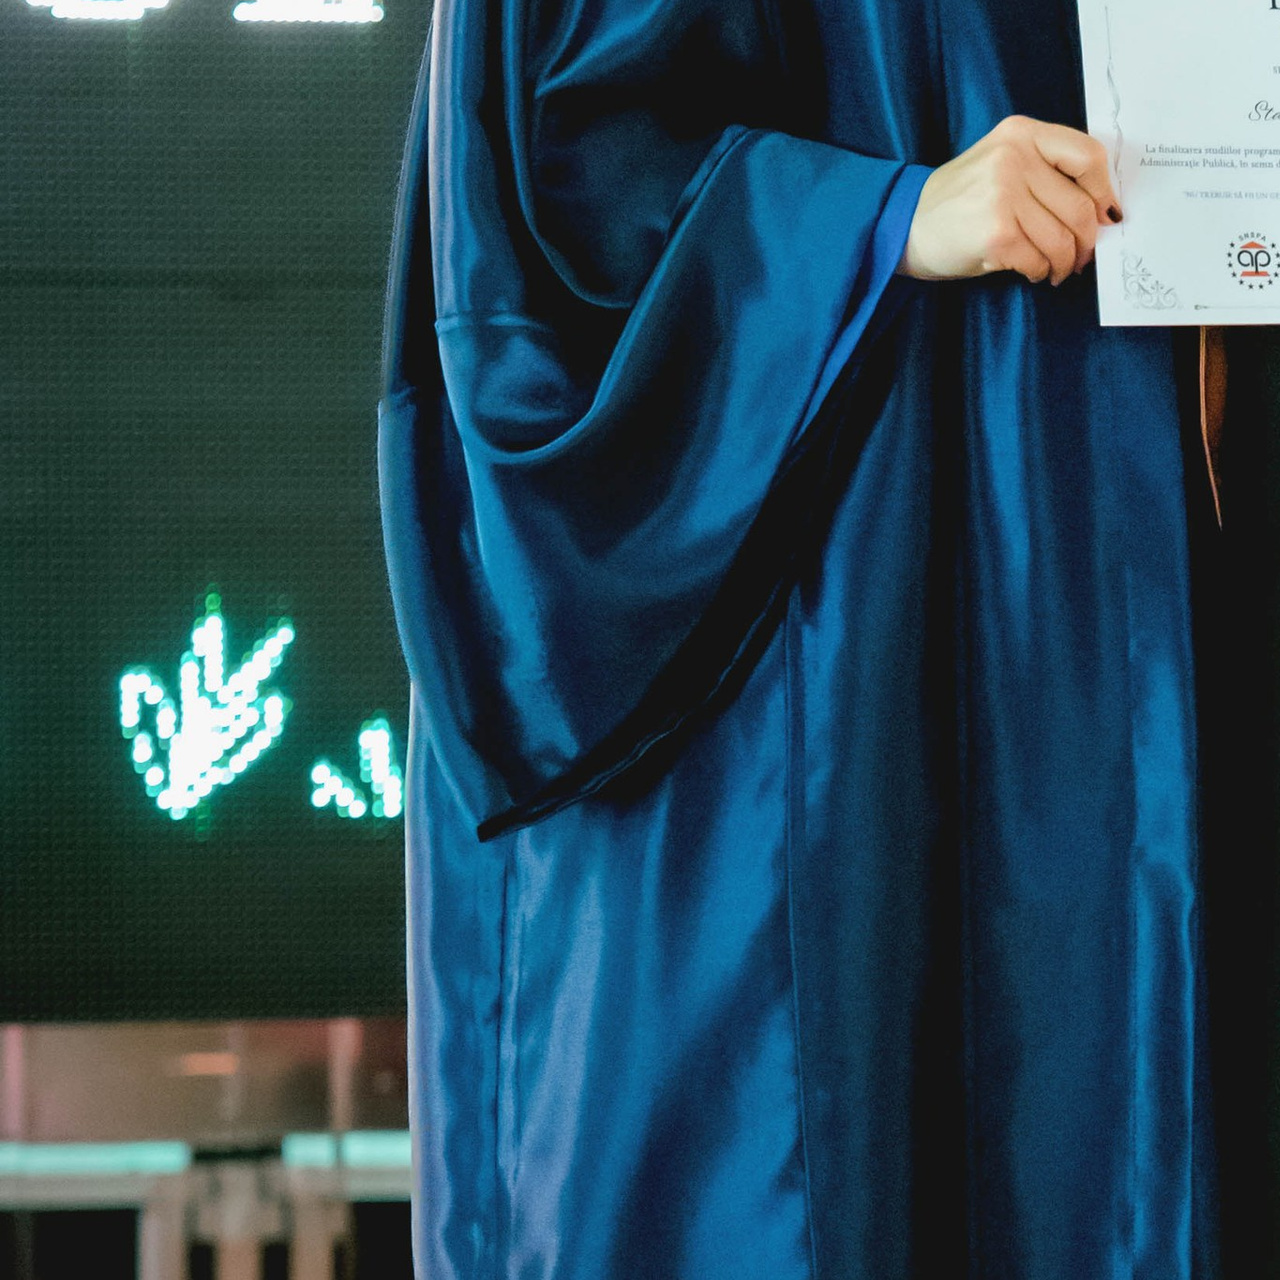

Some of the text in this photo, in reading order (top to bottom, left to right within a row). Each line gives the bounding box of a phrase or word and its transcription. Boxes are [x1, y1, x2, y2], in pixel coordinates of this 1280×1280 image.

[1145, 144, 1156, 153] La
[1158, 144, 1202, 154] finalizarea
[1204, 145, 1241, 154] studiilor
[1238, 231, 1267, 242] SNSPA
